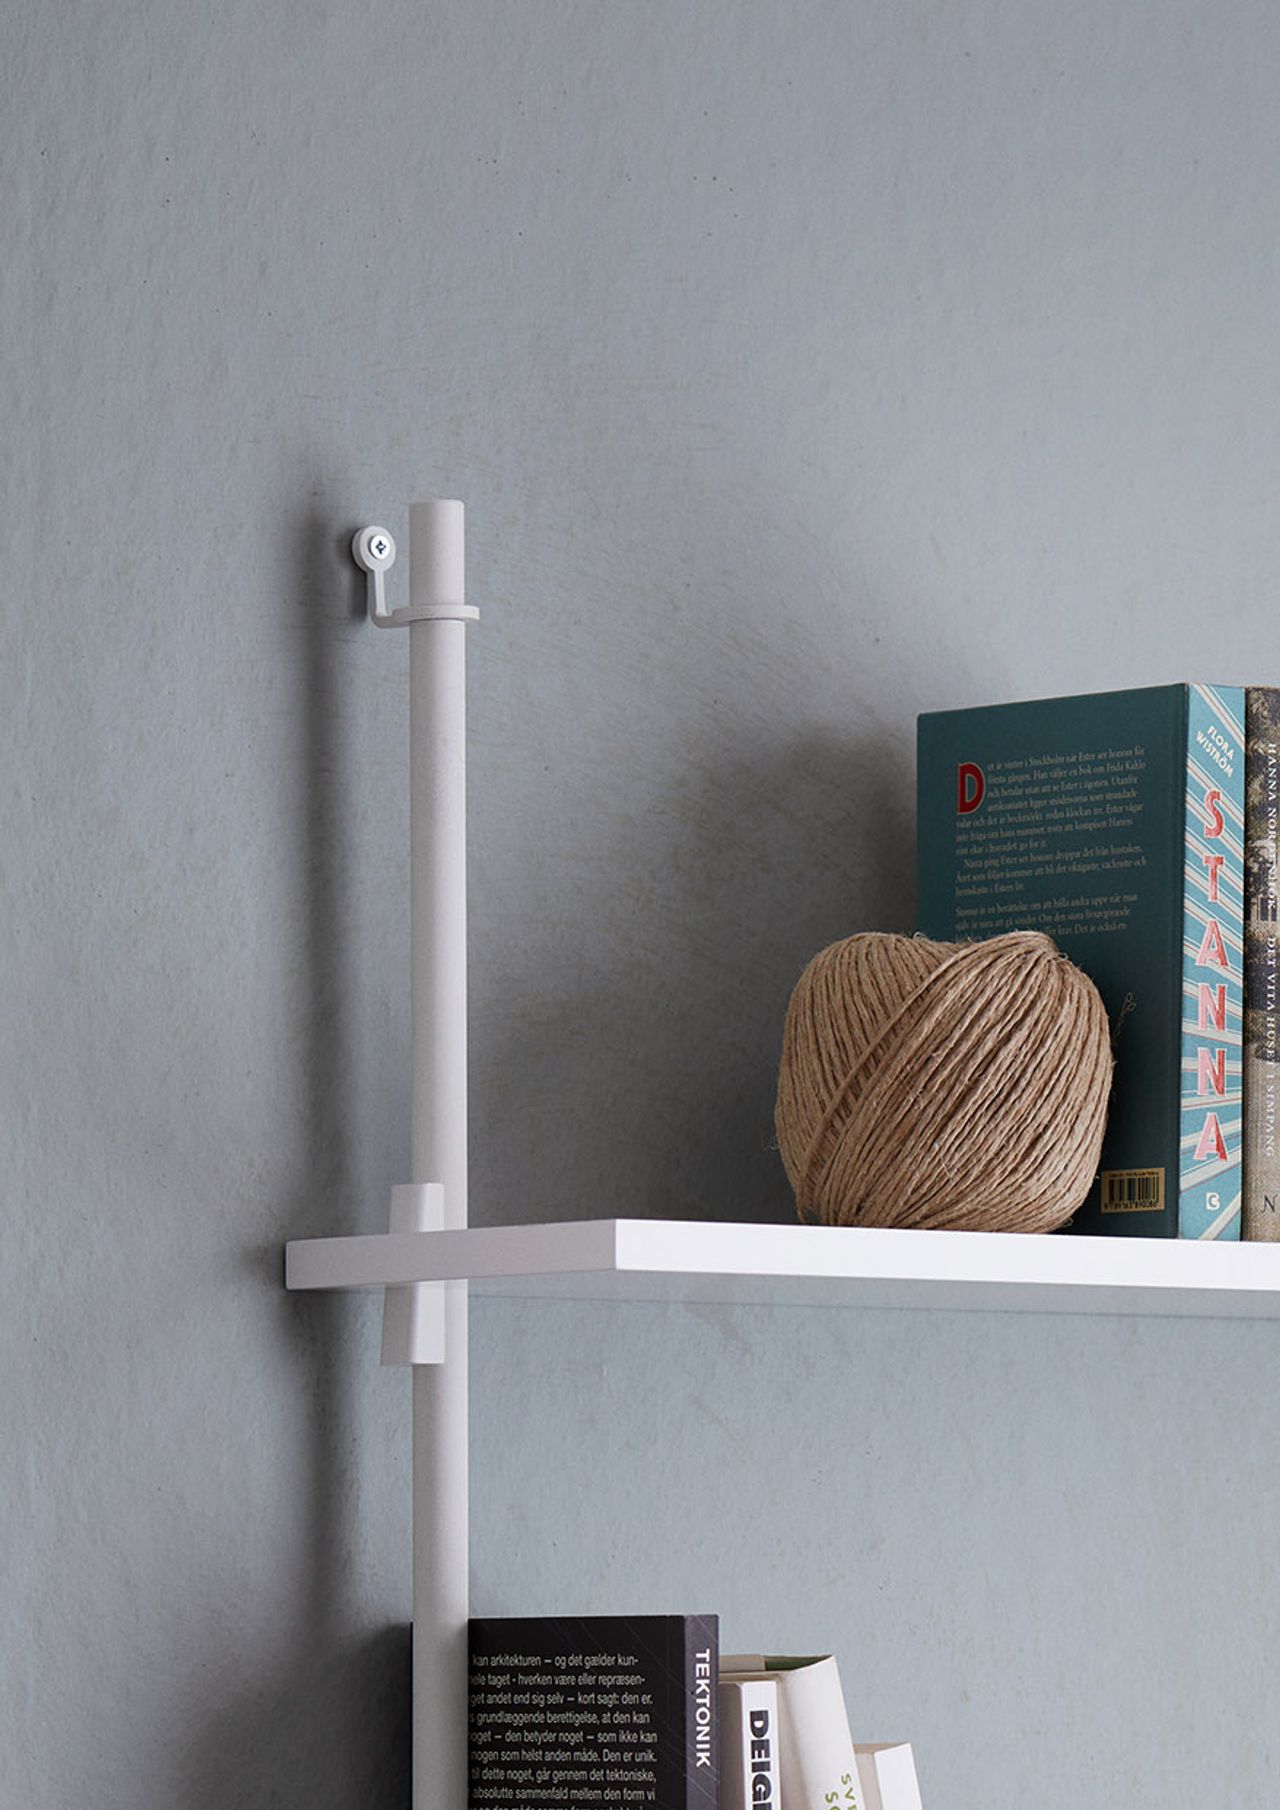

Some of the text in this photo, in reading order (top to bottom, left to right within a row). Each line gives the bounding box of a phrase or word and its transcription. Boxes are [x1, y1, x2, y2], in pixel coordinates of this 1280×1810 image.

[1195, 730, 1234, 778] WISTRÖM
[1207, 725, 1234, 760] FLORA
[1267, 742, 1278, 801] HANNA
[1266, 937, 1277, 968] DET
[1192, 790, 1229, 1162] STANNA
[1266, 973, 1277, 1011] VITA
[1266, 1016, 1276, 1066] HUSET
[1266, 1083, 1276, 1158] SIMPANG
[1260, 1193, 1279, 1214] N
[490, 1655, 542, 1667] arkitekturen
[554, 1655, 566, 1669] og
[568, 1654, 583, 1667] det
[584, 1654, 616, 1669] gælder
[617, 1654, 639, 1667] kun-
[488, 1673, 511, 1688] taget
[518, 1673, 552, 1685] hverken
[554, 1674, 576, 1685] være
[577, 1673, 596, 1685] eller
[598, 1674, 646, 1688] repræsen-
[486, 1692, 512, 1704] andet
[513, 1692, 530, 1704] end
[532, 1692, 545, 1707] sig
[547, 1692, 565, 1705] selv
[577, 1692, 596, 1705] kort
[597, 1693, 619, 1707] sagt:
[621, 1692, 639, 1705] den
[641, 1694, 653, 1705] er.
[695, 1648, 712, 1768] TEKTONIK
[477, 1711, 546, 1727] grundlæggende
[547, 1711, 600, 1727] berettigelse,
[612, 1712, 630, 1724] den
[632, 1712, 650, 1724] kan
[505, 1730, 522, 1743] den
[523, 1730, 558, 1746] betyder
[558, 1730, 584, 1746] noget
[597, 1732, 617, 1743] som
[619, 1730, 638, 1743] ikke
[639, 1730, 657, 1743] kan
[500, 1751, 519, 1761] som
[521, 1749, 543, 1761] helst
[544, 1749, 572, 1761] anden
[573, 1748, 601, 1762] måde.
[602, 1749, 621, 1762] Den
[623, 1751, 633, 1762] er
[634, 1750, 657, 1763] unik.
[481, 1767, 656, 1784] dette noget, går gennem det tektoniske,
[515, 1787, 569, 1799] sammenfald
[570, 1788, 602, 1800] mellem
[604, 1787, 621, 1800] den
[623, 1787, 645, 1800] form
